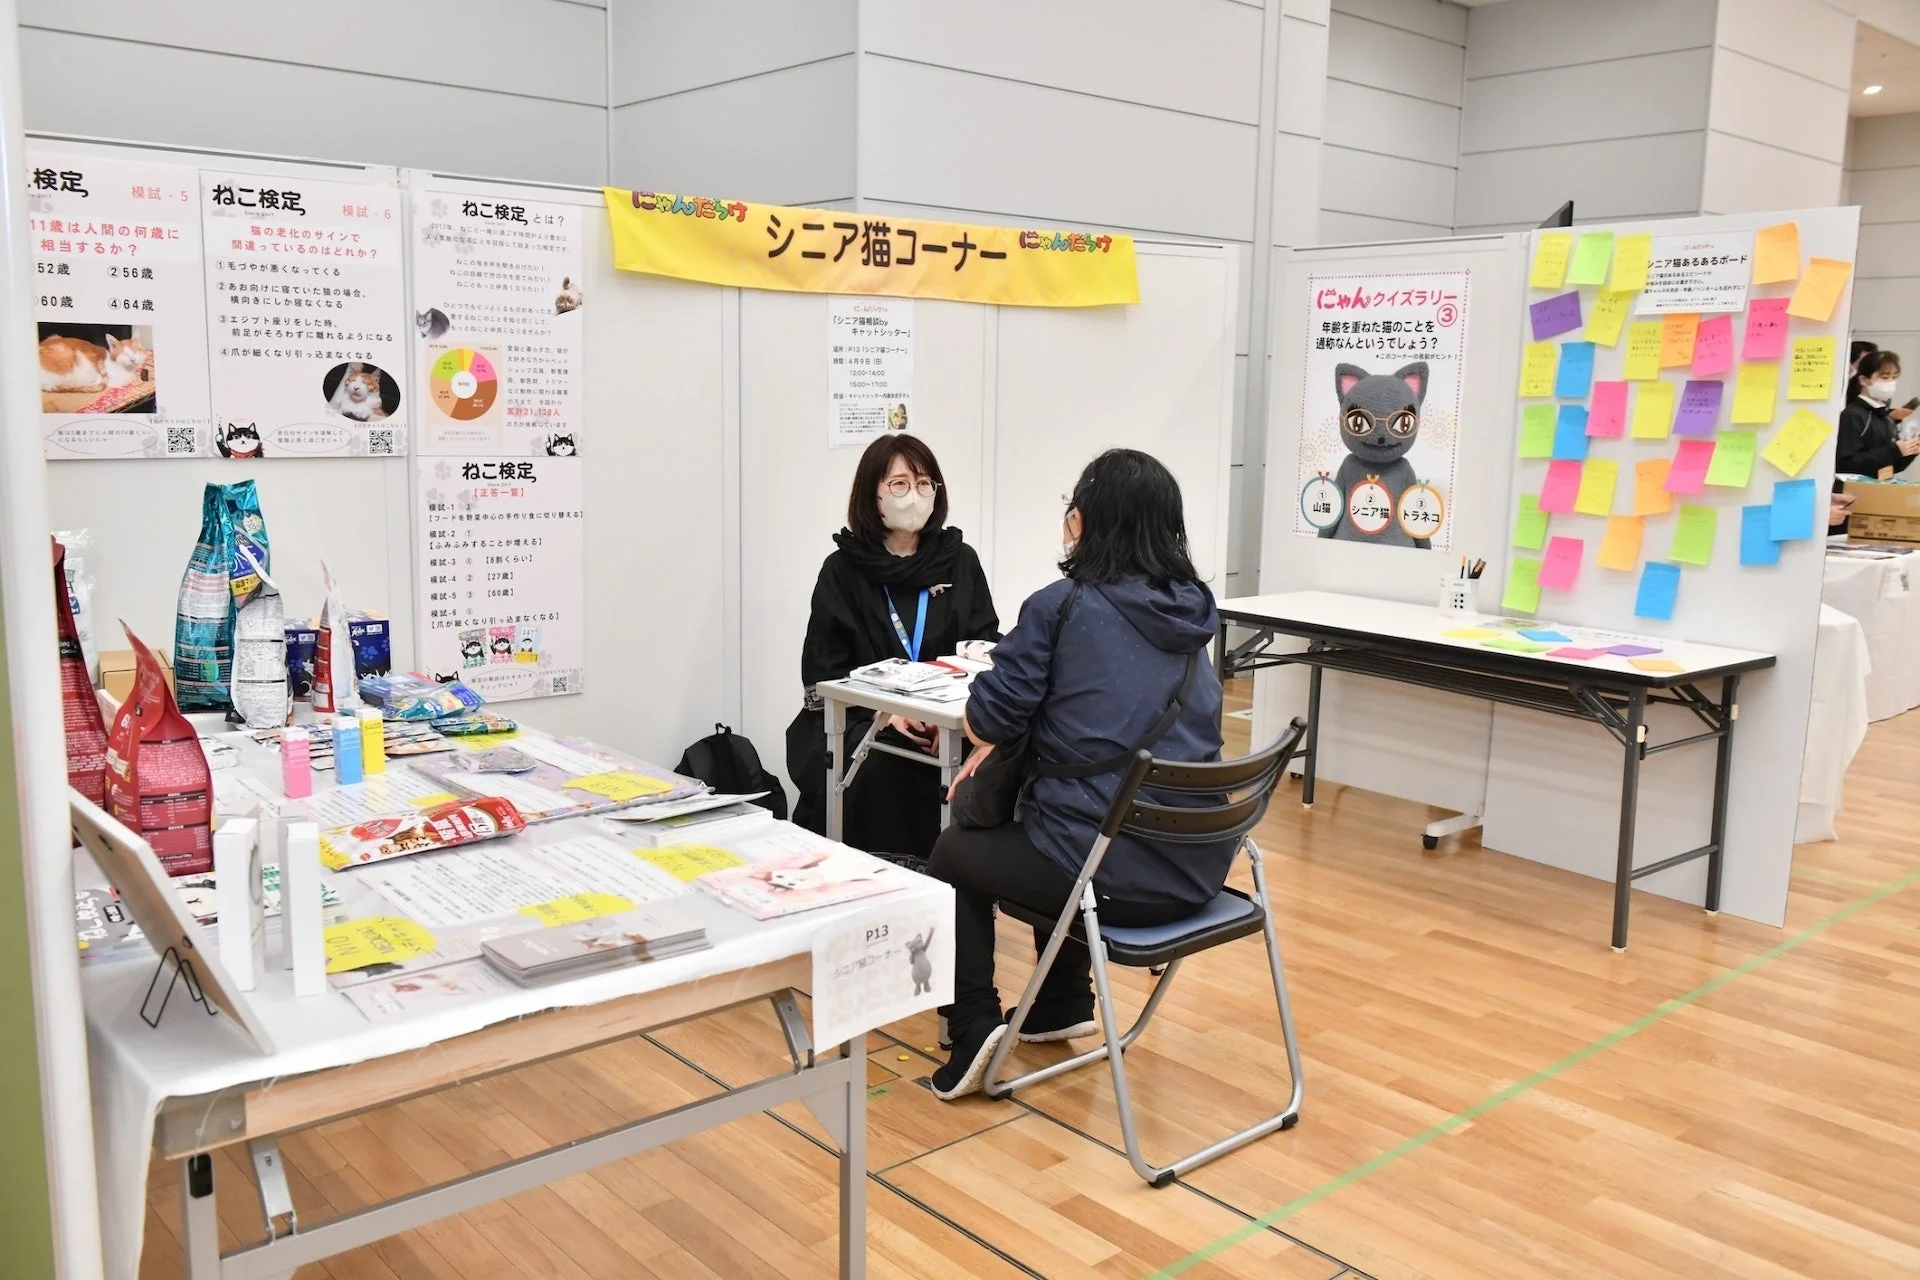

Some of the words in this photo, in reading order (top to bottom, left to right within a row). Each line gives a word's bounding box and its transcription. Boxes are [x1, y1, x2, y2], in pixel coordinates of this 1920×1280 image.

[28, 168, 89, 198] 検定
[213, 185, 306, 216] ねこ検定
[631, 190, 747, 222] にゃんだらけ
[462, 200, 528, 226] ねこ検定
[251, 226, 360, 243] 猫の老化のサインで
[766, 213, 1007, 272] シニア猫コーナー
[1019, 231, 1112, 253] にゃんだらけ
[41, 239, 137, 256] 相当するか?
[232, 239, 377, 259] 間違っているのはどれか?
[1322, 320, 1435, 334] 年齢を重ねた猫のことを
[1316, 337, 1438, 350] 通称なんというでしょう?
[462, 462, 537, 483] ねこ検定
[1313, 502, 1331, 514] 山猫
[1352, 505, 1389, 519] シニア猫
[1402, 509, 1440, 523] トラネコ
[866, 924, 889, 942] P13
